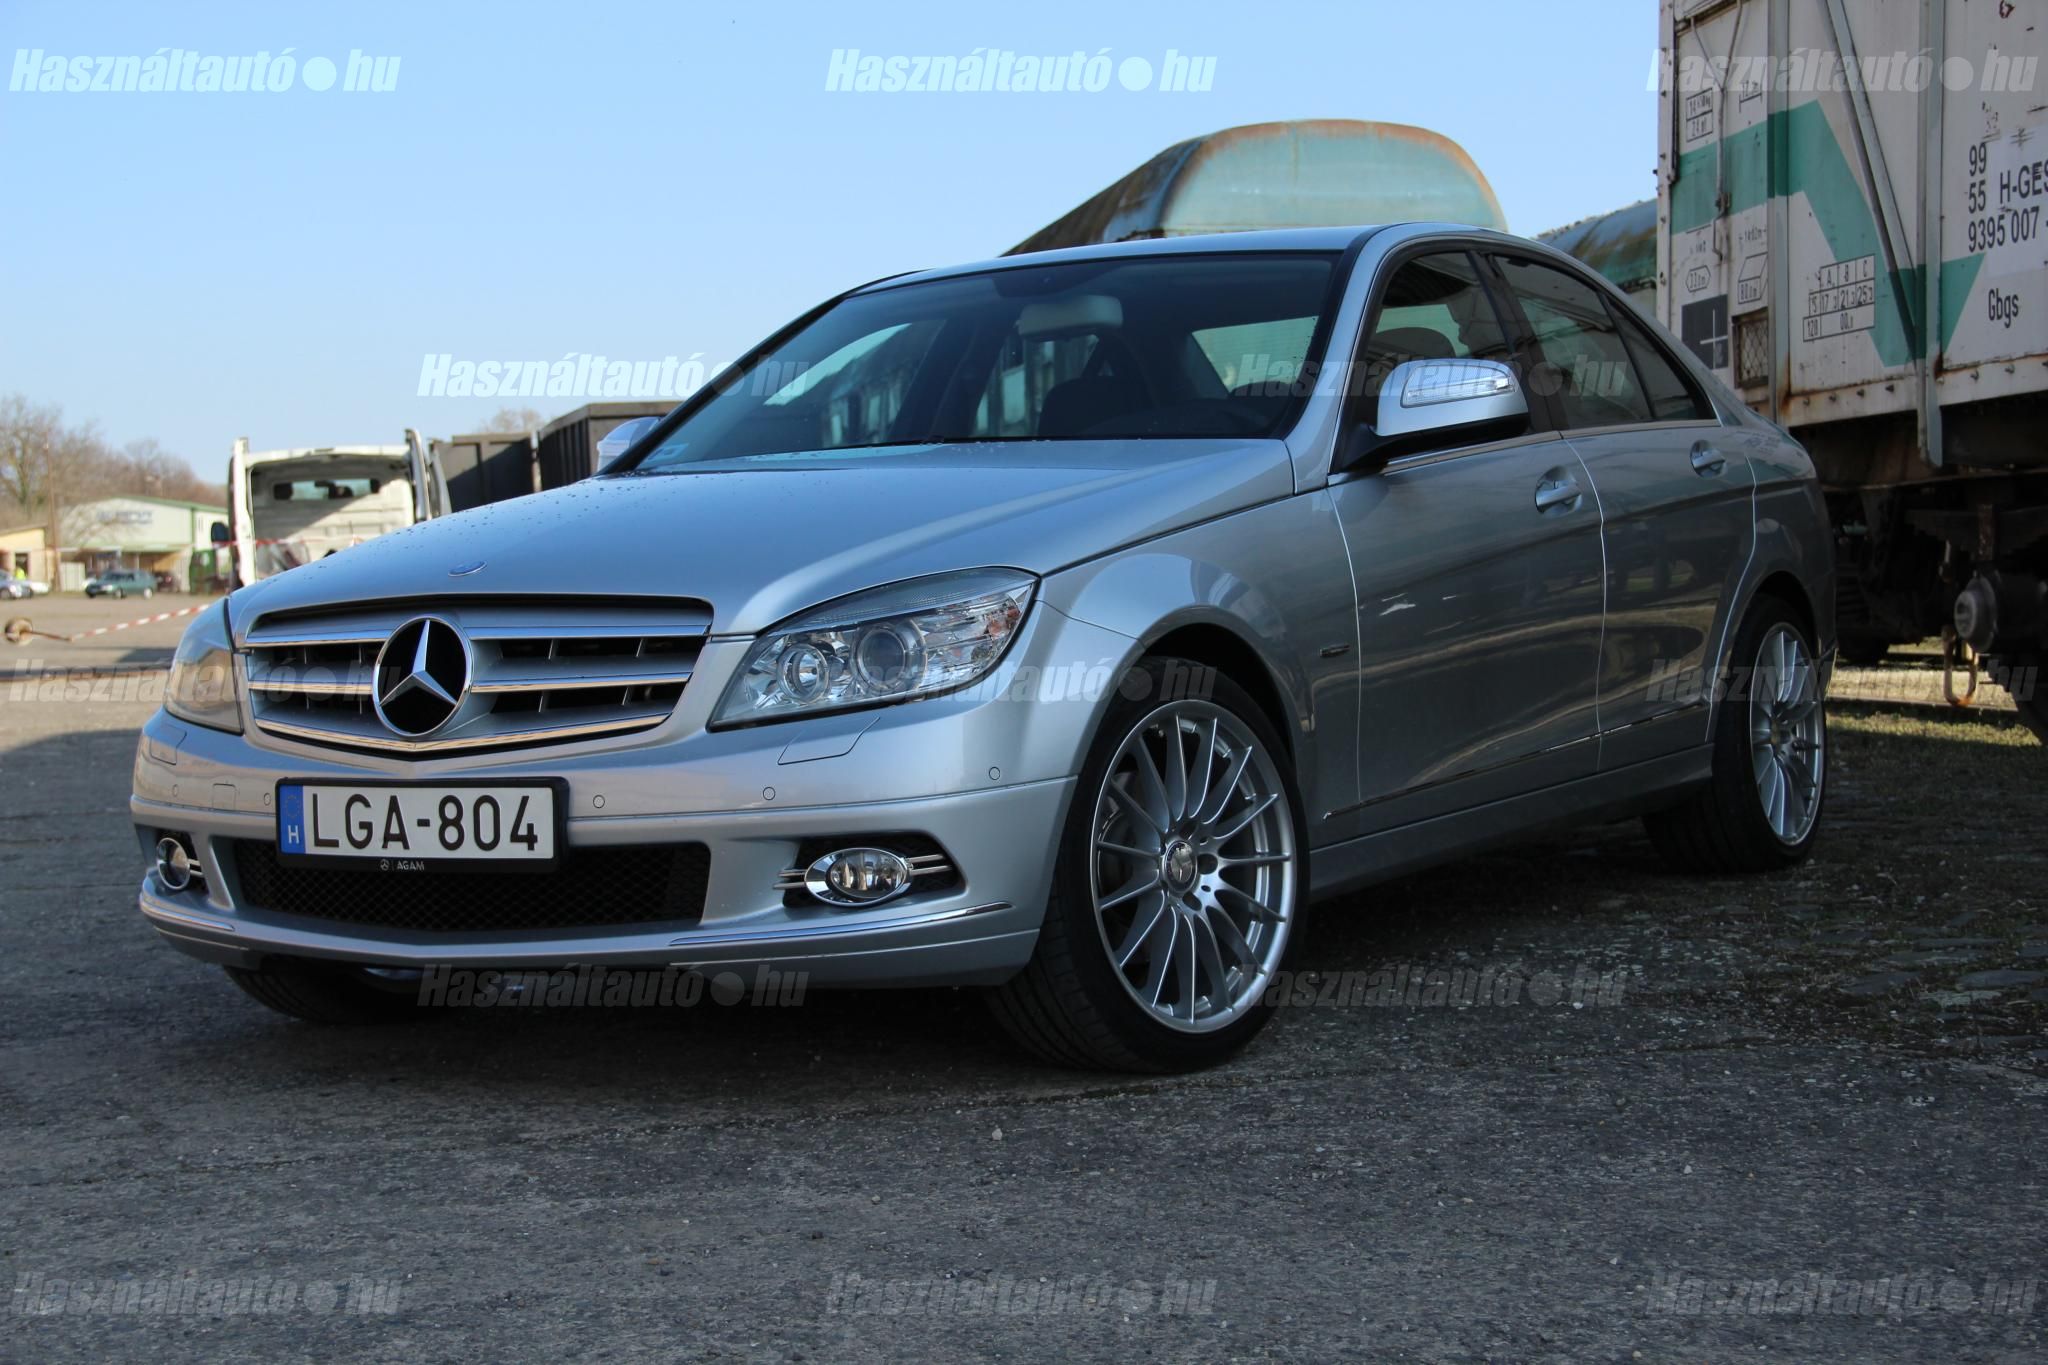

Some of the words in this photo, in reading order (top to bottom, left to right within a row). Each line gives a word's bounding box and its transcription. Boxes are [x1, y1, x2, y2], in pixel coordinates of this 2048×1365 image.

[1969, 142, 1987, 177] 99
[1968, 179, 1986, 214] 55
[1968, 214, 2005, 253] 9395
[2011, 205, 2040, 244] 007
[1988, 287, 2019, 329] Gbgs
[288, 825, 300, 844] H
[312, 793, 538, 851] LGA-804
[397, 860, 425, 871] AGAM
